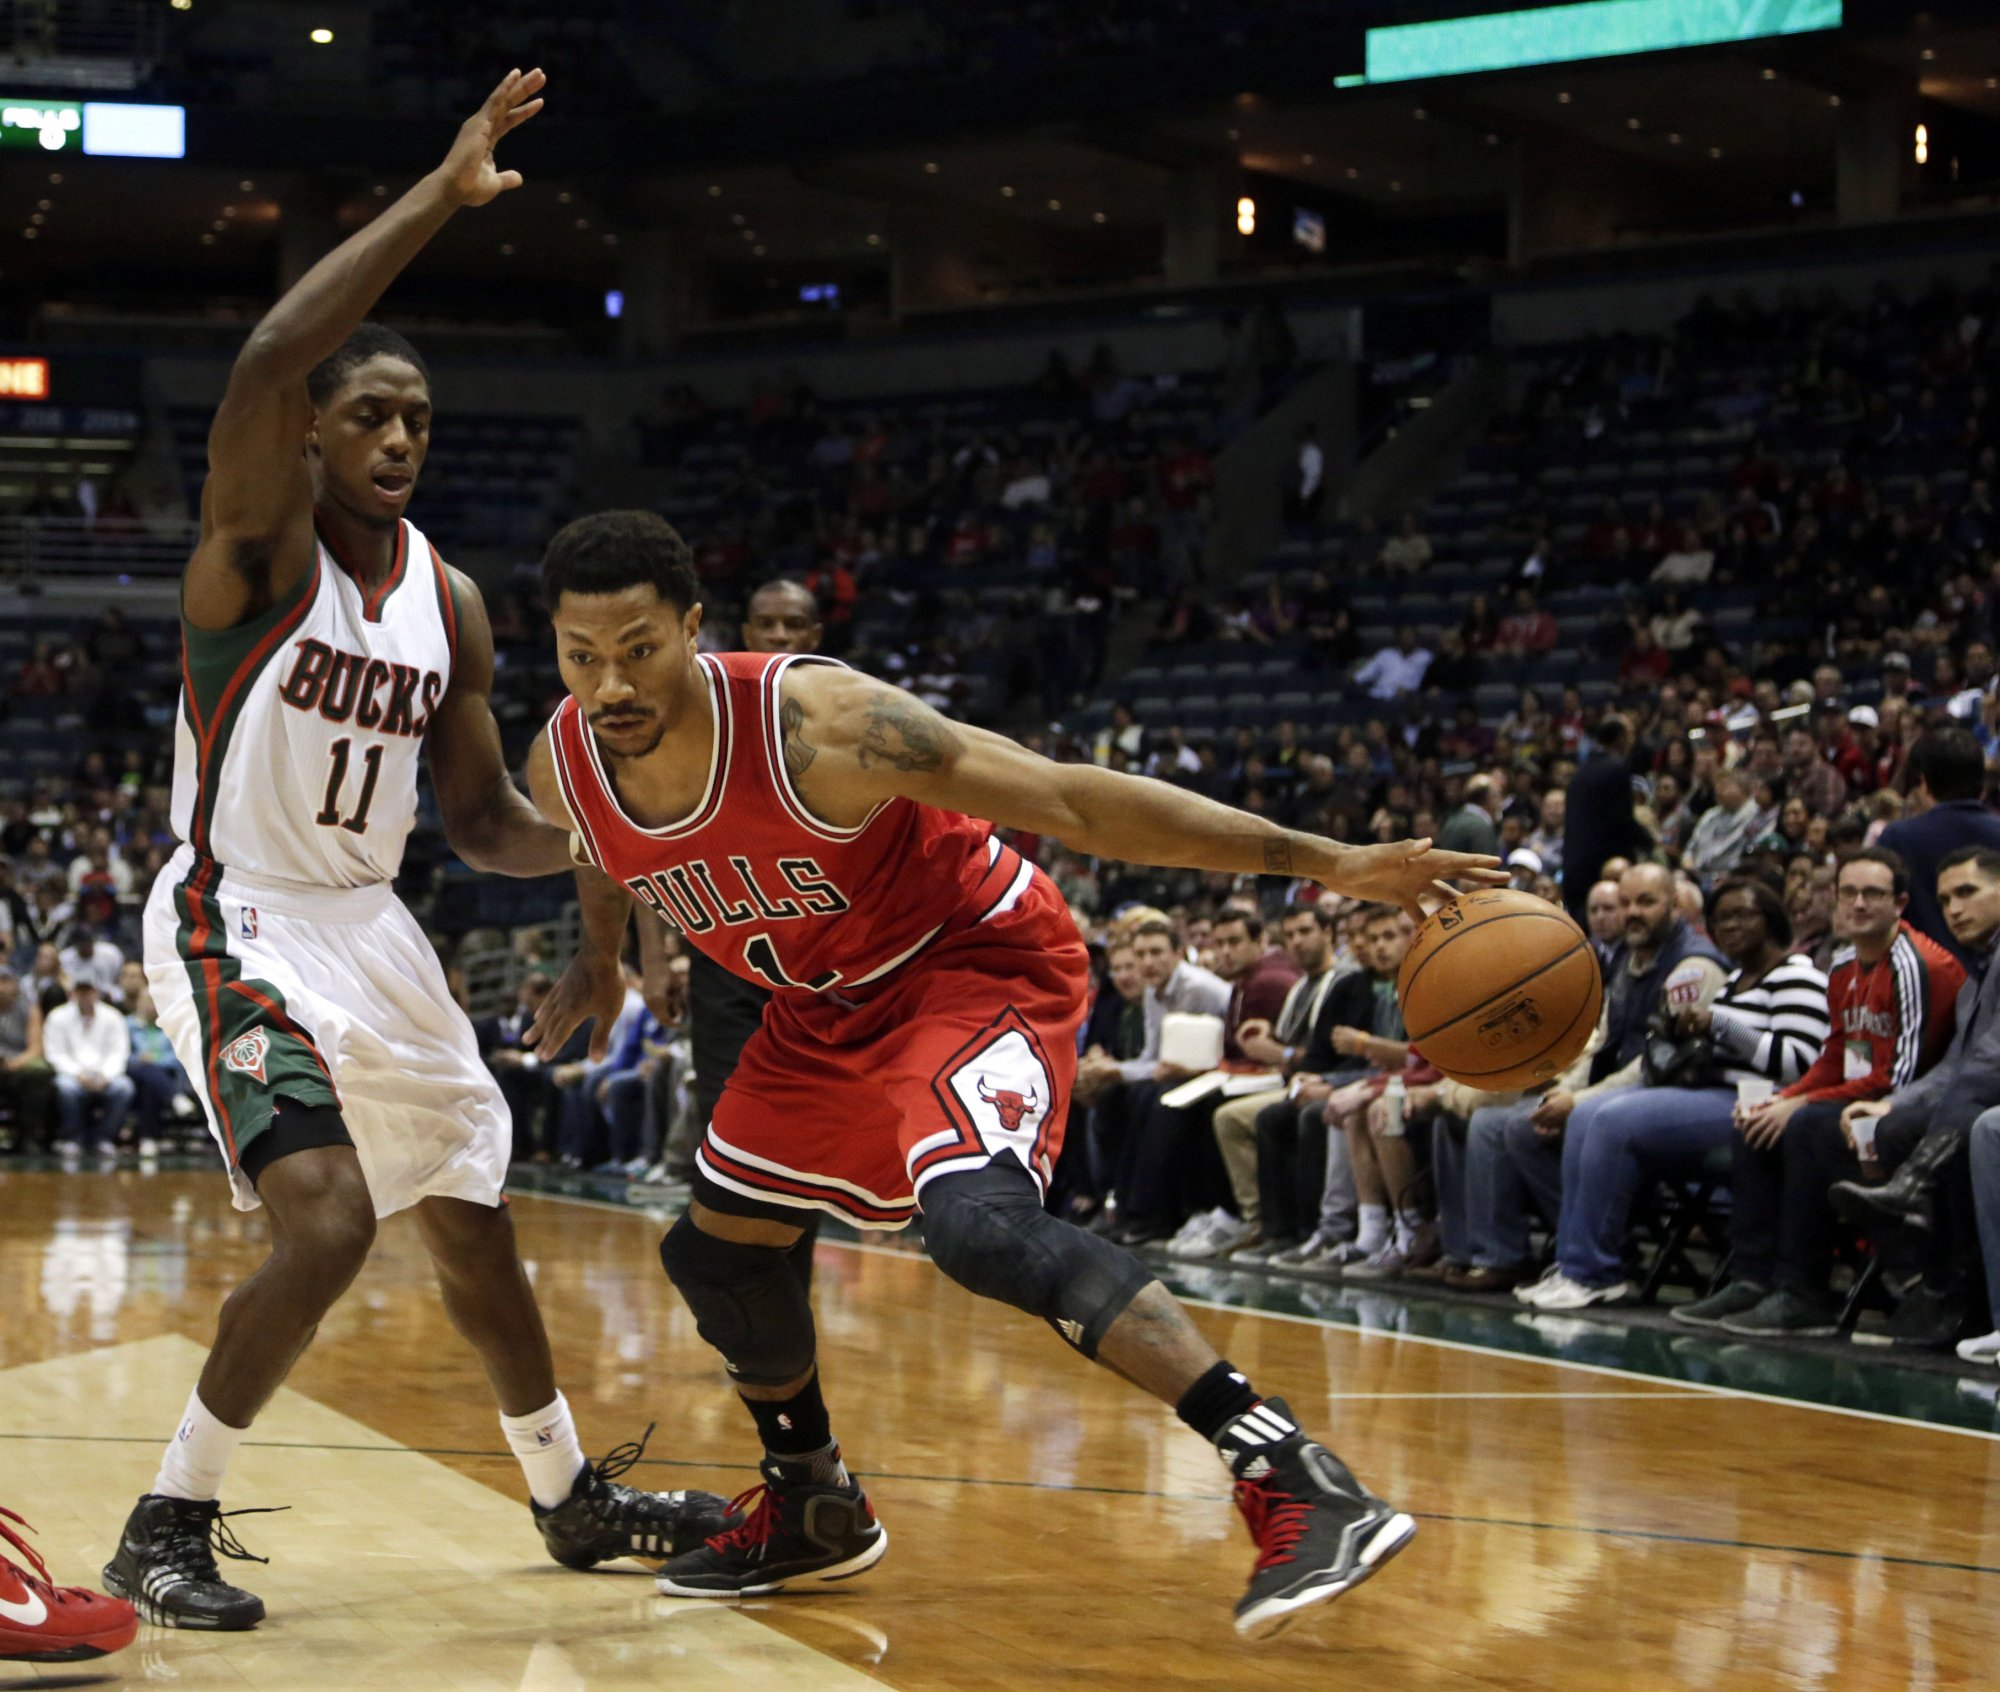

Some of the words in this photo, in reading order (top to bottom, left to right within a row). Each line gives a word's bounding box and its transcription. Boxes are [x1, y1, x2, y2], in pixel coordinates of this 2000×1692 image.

[279, 638, 442, 738] BUCKS
[315, 737, 385, 835] 11
[624, 856, 849, 934] BULLS
[743, 933, 843, 992] 1
